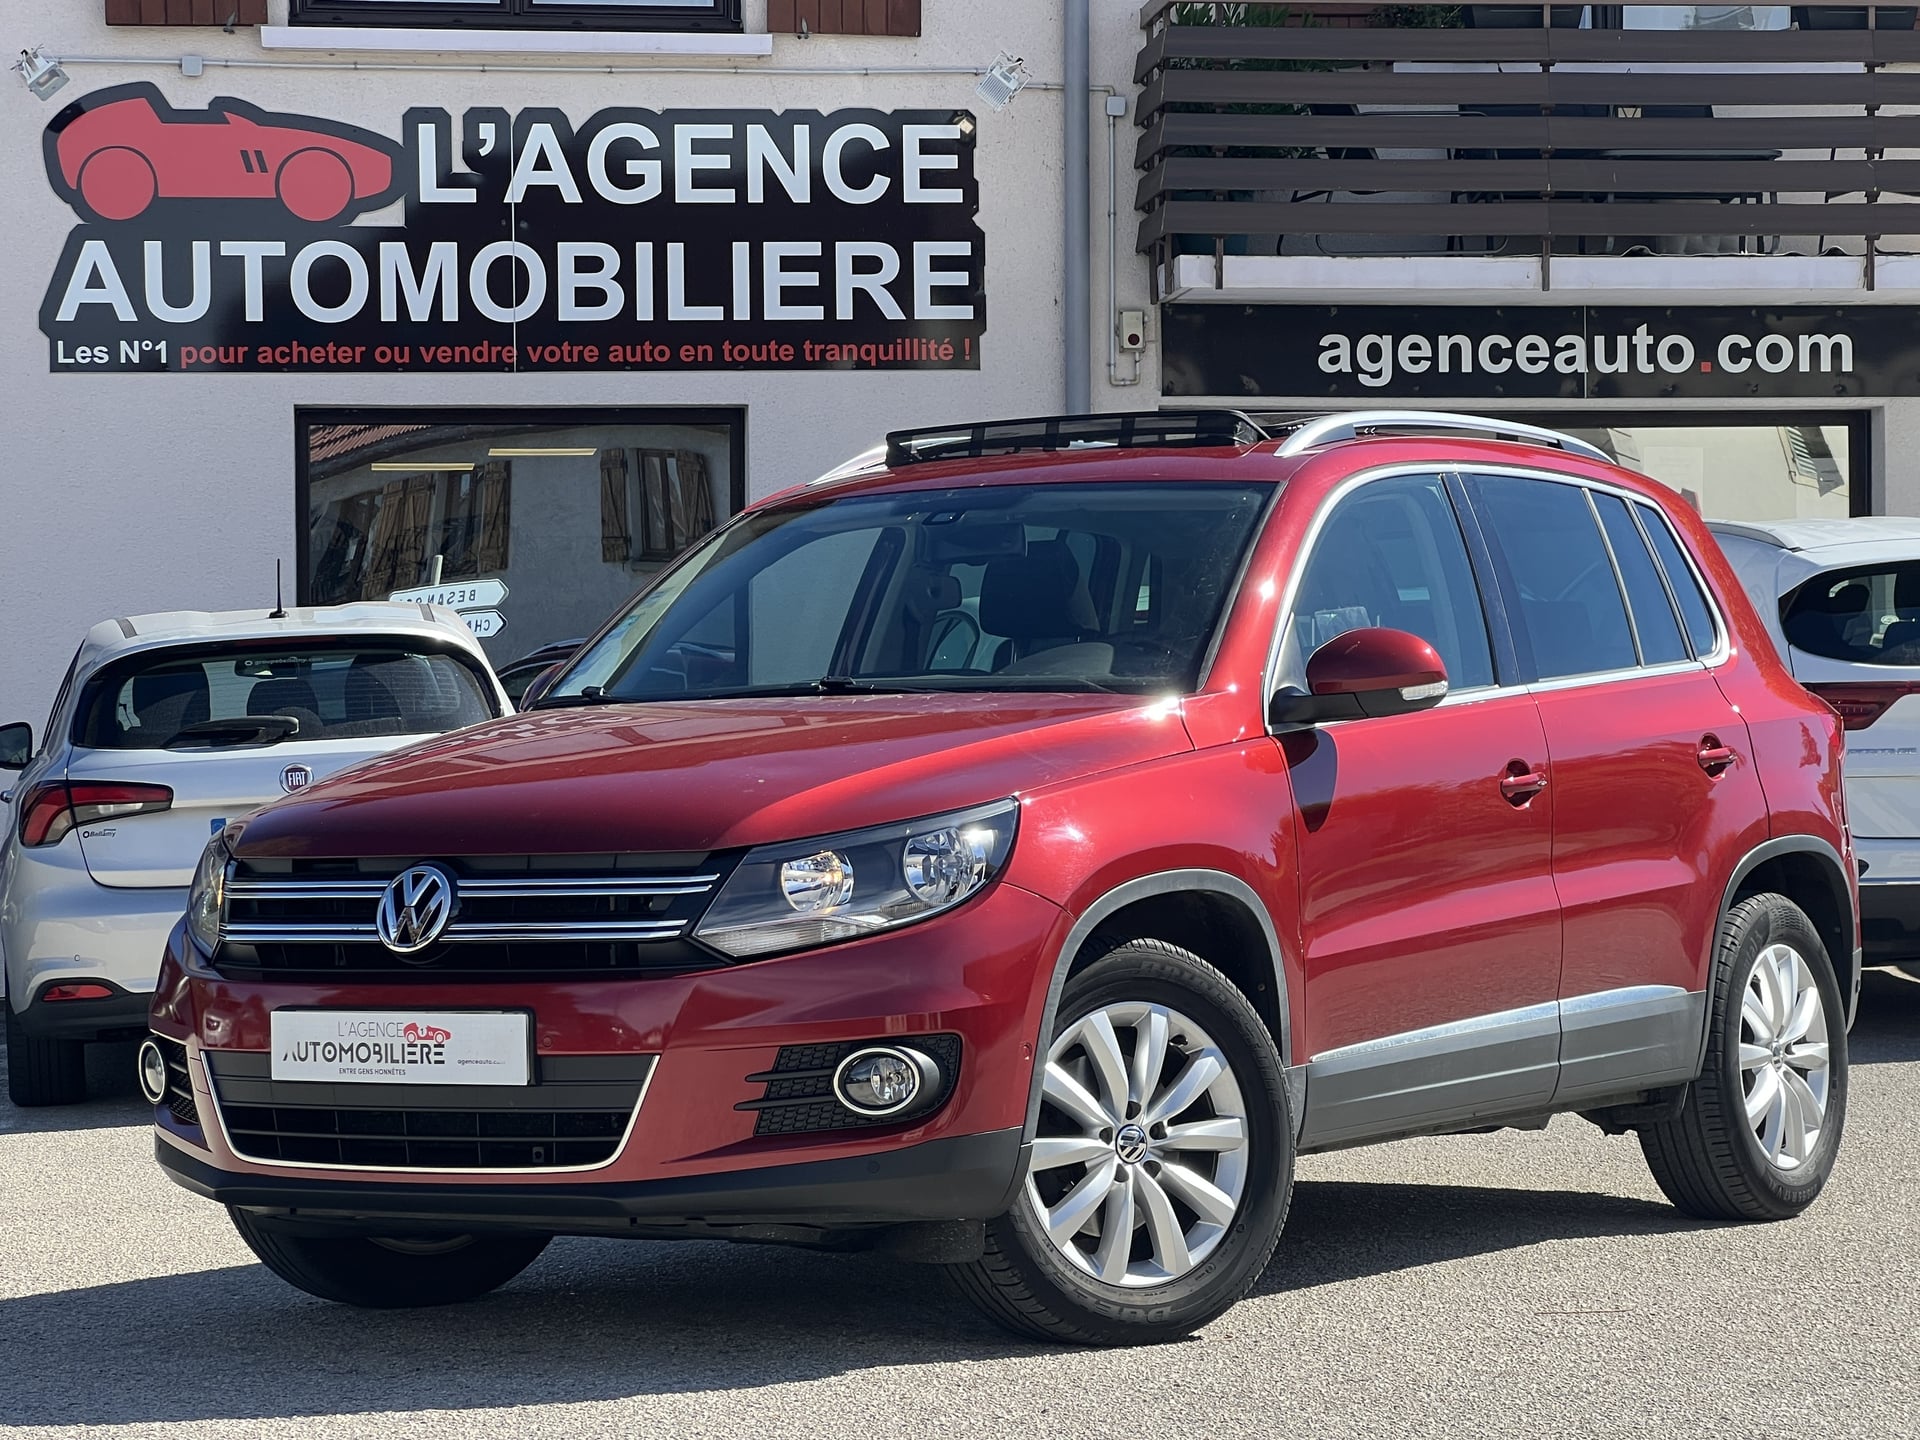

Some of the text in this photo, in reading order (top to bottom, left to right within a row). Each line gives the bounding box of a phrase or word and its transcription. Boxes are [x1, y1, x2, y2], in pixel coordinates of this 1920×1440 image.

[418, 122, 963, 204] L'AGENCE
[56, 240, 973, 323] AUTOMOBILIERE
[57, 340, 109, 364] Les
[119, 340, 168, 364] N°1
[181, 346, 248, 368] pour
[257, 341, 366, 364] acheter
[374, 346, 410, 363] ou
[419, 341, 518, 363] vendre
[526, 341, 600, 363] votre
[608, 341, 671, 363] auto
[679, 344, 713, 362] en
[722, 339, 795, 362] toute
[803, 337, 954, 366] tranquillité
[1318, 323, 1853, 387] agenceauto.com
[287, 771, 307, 787] FIAT
[338, 1021, 405, 1038] L'AGENCE
[283, 1041, 445, 1065] AUTOMOBILIERE
[339, 1067, 357, 1075] ENTRE
